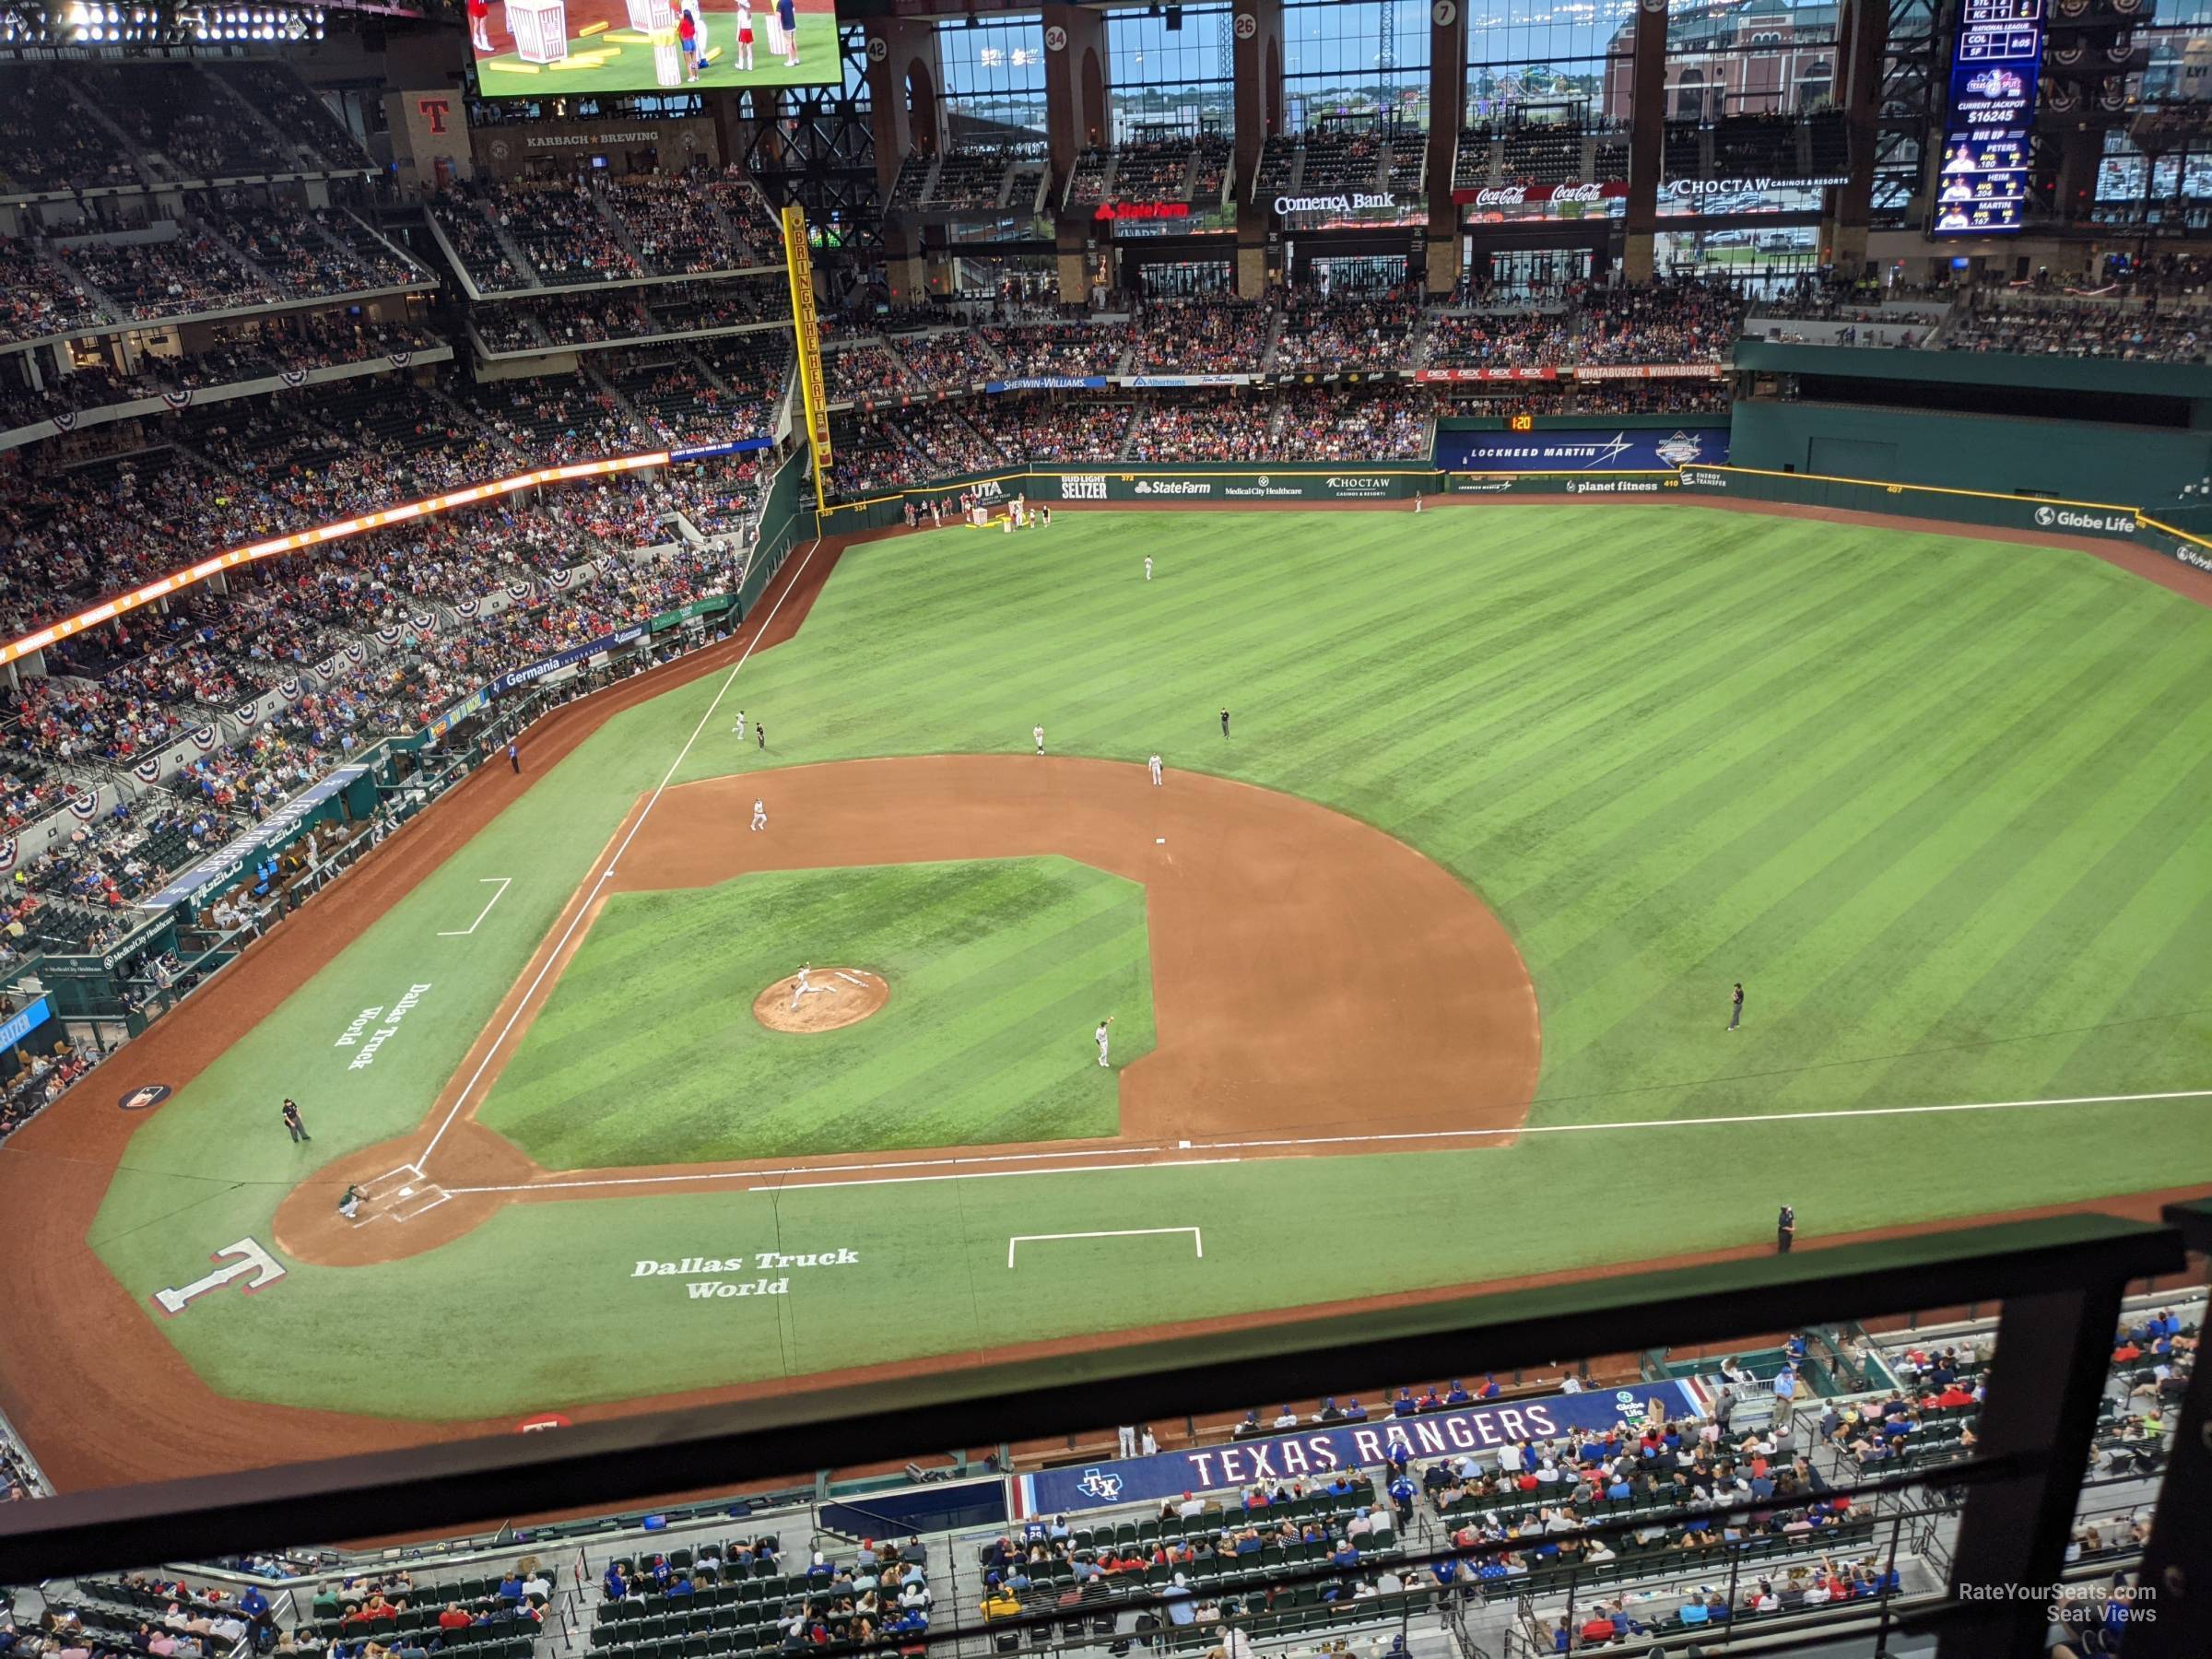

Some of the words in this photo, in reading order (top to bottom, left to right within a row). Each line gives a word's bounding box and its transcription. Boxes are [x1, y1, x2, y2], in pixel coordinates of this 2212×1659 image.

[1439, 6, 1450, 21] 7
[1973, 10, 1987, 18] KC
[1236, 19, 1253, 34] 26
[1972, 24, 2003, 32] NATIONAL
[1048, 32, 1065, 45] 34
[1968, 35, 1987, 44] COL
[869, 42, 885, 56] 42
[1970, 47, 1982, 56] SF
[1958, 102, 1991, 110] CURRENT
[1992, 100, 2026, 109] JACKPOT
[418, 99, 449, 135] T
[1967, 111, 2014, 124] $16245
[527, 135, 589, 147] KARBACH
[600, 131, 659, 144] BREWING
[1972, 131, 1989, 141] DUE
[1991, 130, 2005, 140] UP
[1987, 143, 2018, 153] PETERS
[1677, 178, 1771, 194] CHOCTAW
[1942, 178, 1950, 188] 6
[1987, 174, 2010, 182] HEIM
[1476, 187, 1527, 206] Coca-Cola
[1551, 183, 1604, 202] Coca-Cola
[1352, 192, 1395, 209] Bank
[1939, 206, 1947, 216] 7
[1978, 201, 2012, 210] MARTIN
[795, 231, 811, 303] BRING
[803, 309, 816, 350] THE
[810, 355, 824, 411] HEAT
[1577, 368, 1644, 379] WHATABURGER
[1648, 365, 1716, 377] WHATABURGER
[1147, 378, 1186, 386] Albertsons
[1201, 376, 1213, 384] Tom
[1471, 448, 1539, 458] LOCKHEED
[1544, 447, 1596, 457] MARTIN
[971, 481, 1003, 499] UTA
[1334, 478, 1390, 488] CHOCTAW
[1577, 480, 1615, 492] planet
[1617, 479, 1658, 491] fitness
[1696, 478, 1727, 487] TRANSFER
[1062, 482, 1107, 499] SELTZER
[1251, 488, 1265, 496] City
[2058, 512, 2101, 530] Globe
[2105, 517, 2136, 533] Life
[506, 658, 560, 687] Germania
[561, 645, 604, 666] INSURANCE
[264, 798, 319, 827] TEXAS
[262, 818, 303, 849] GEICO
[197, 830, 270, 873] RANGERS
[113, 943, 135, 963] Medical
[135, 935, 147, 948] City
[146, 915, 175, 939] Healthcare
[384, 983, 432, 1024] Dallas
[334, 1006, 384, 1047] World
[347, 1026, 399, 1070] Truck
[630, 1257, 743, 1277] Dallas
[755, 1248, 859, 1269] Truck
[148, 1235, 288, 1320] T
[685, 1277, 790, 1299] World
[1616, 1402, 1645, 1411] Globe
[1624, 1409, 1644, 1417] Life
[1189, 1436, 1337, 1487] TEXAS
[1355, 1405, 1557, 1463] RANGERS
[1030, 1531, 1042, 1541] 29
